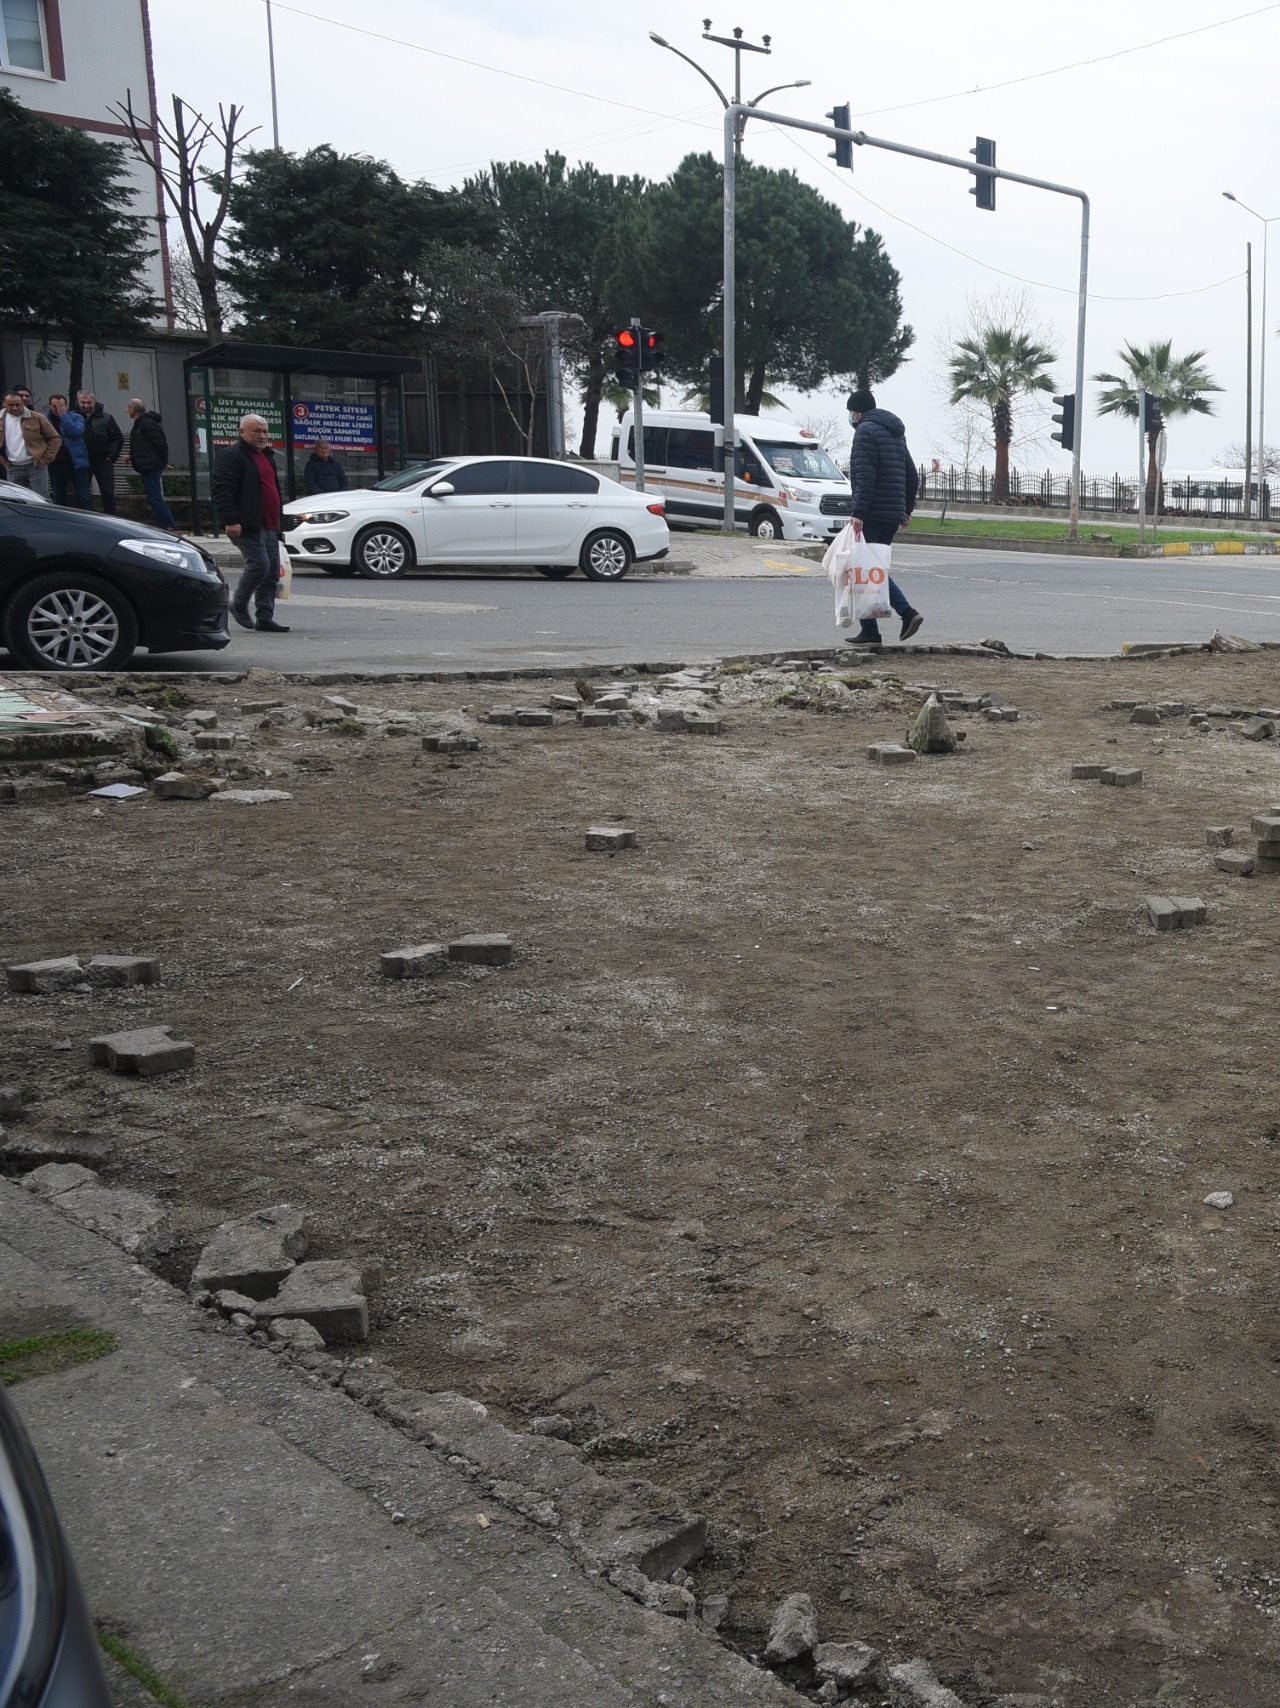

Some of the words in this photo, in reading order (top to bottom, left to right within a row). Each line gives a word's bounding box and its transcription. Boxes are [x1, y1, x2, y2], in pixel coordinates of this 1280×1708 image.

[218, 398, 234, 406] ÜST
[297, 406, 305, 416] 3
[342, 405, 367, 414] SİTESİ
[211, 422, 238, 430] KÜÇÜK
[294, 418, 321, 426] SAĞLIK
[307, 426, 332, 434] KÜÇÜK
[844, 567, 885, 586] FLO
